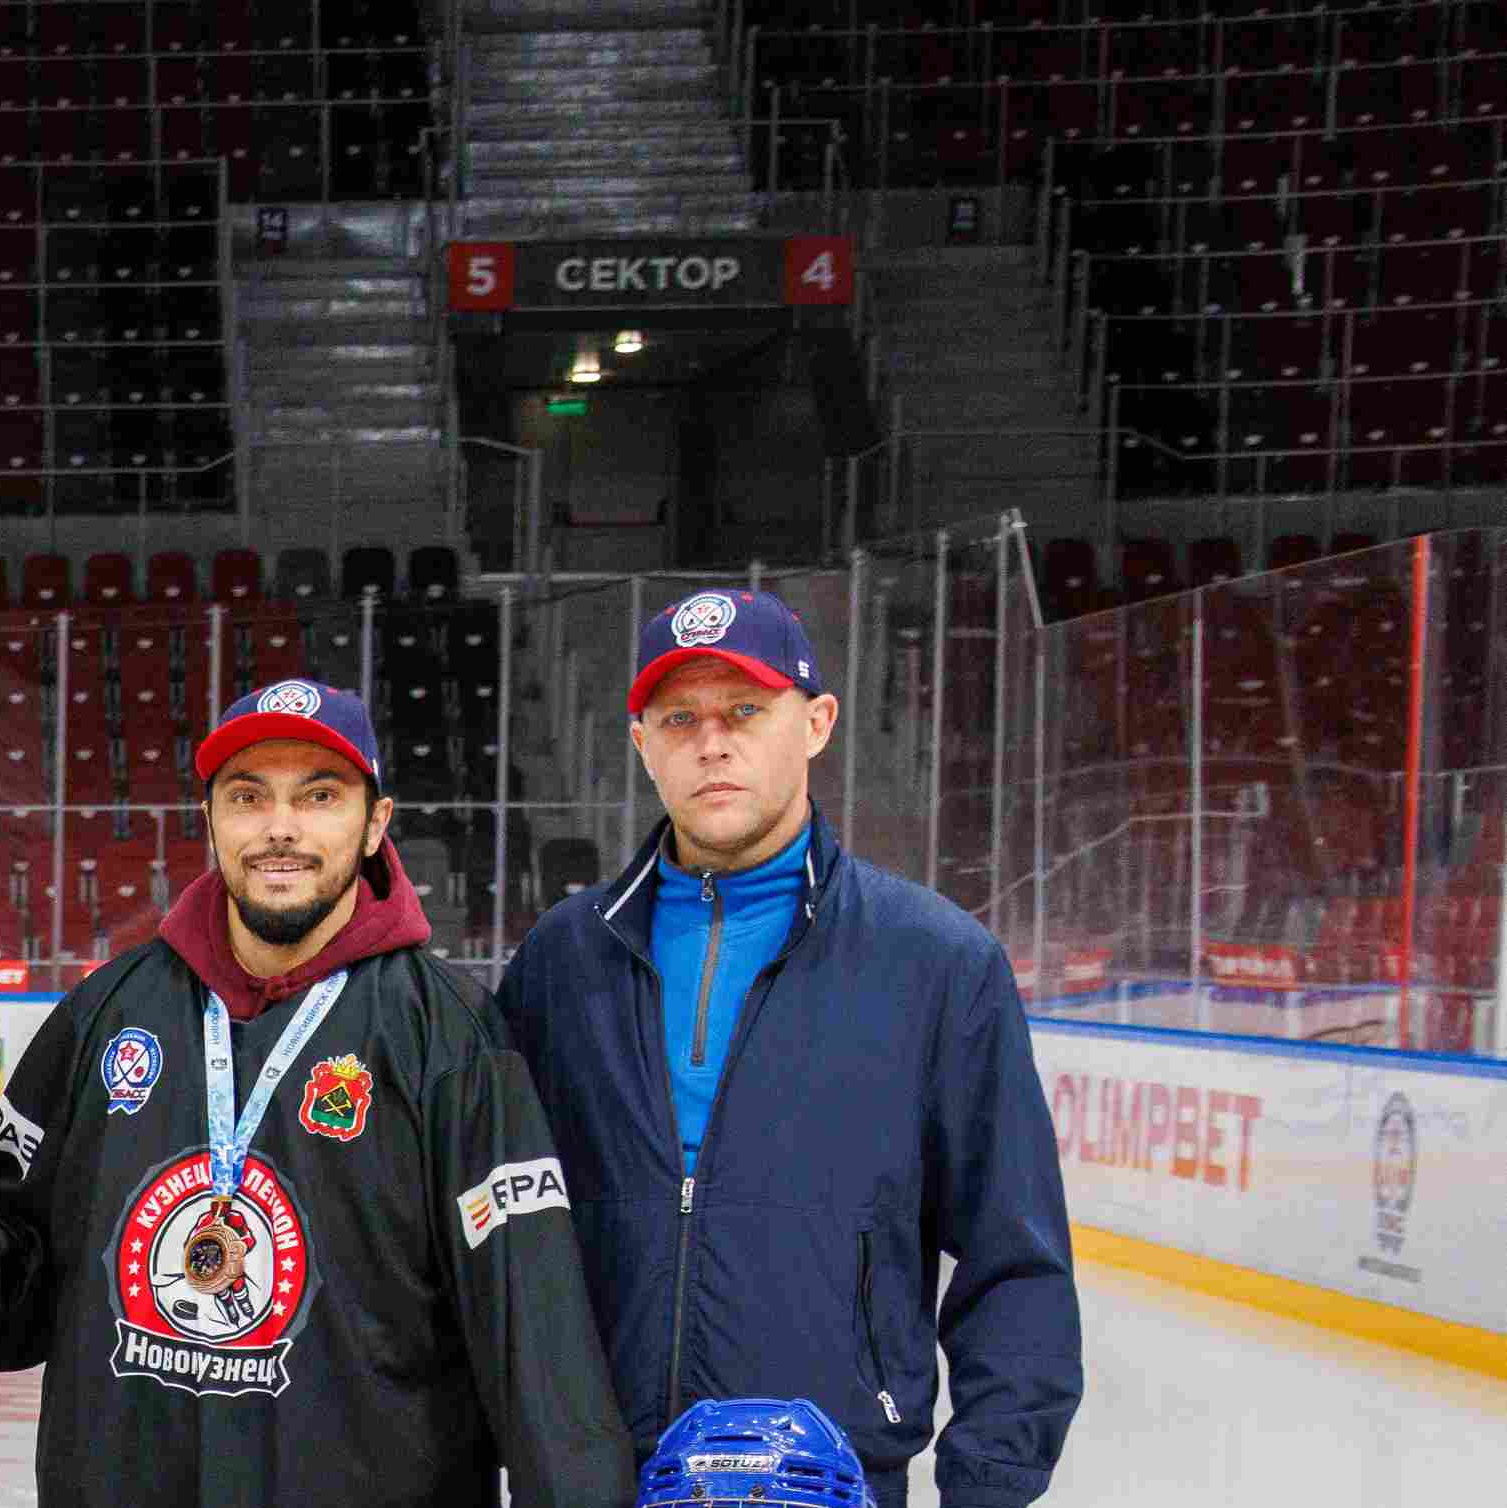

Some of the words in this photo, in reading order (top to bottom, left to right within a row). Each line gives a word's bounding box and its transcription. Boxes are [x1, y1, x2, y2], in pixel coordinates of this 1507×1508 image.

[465, 265, 495, 297] 5
[554, 255, 742, 294] СЕКТОР
[801, 252, 834, 288] 4
[1051, 1072, 1263, 1193] OLIMPBET
